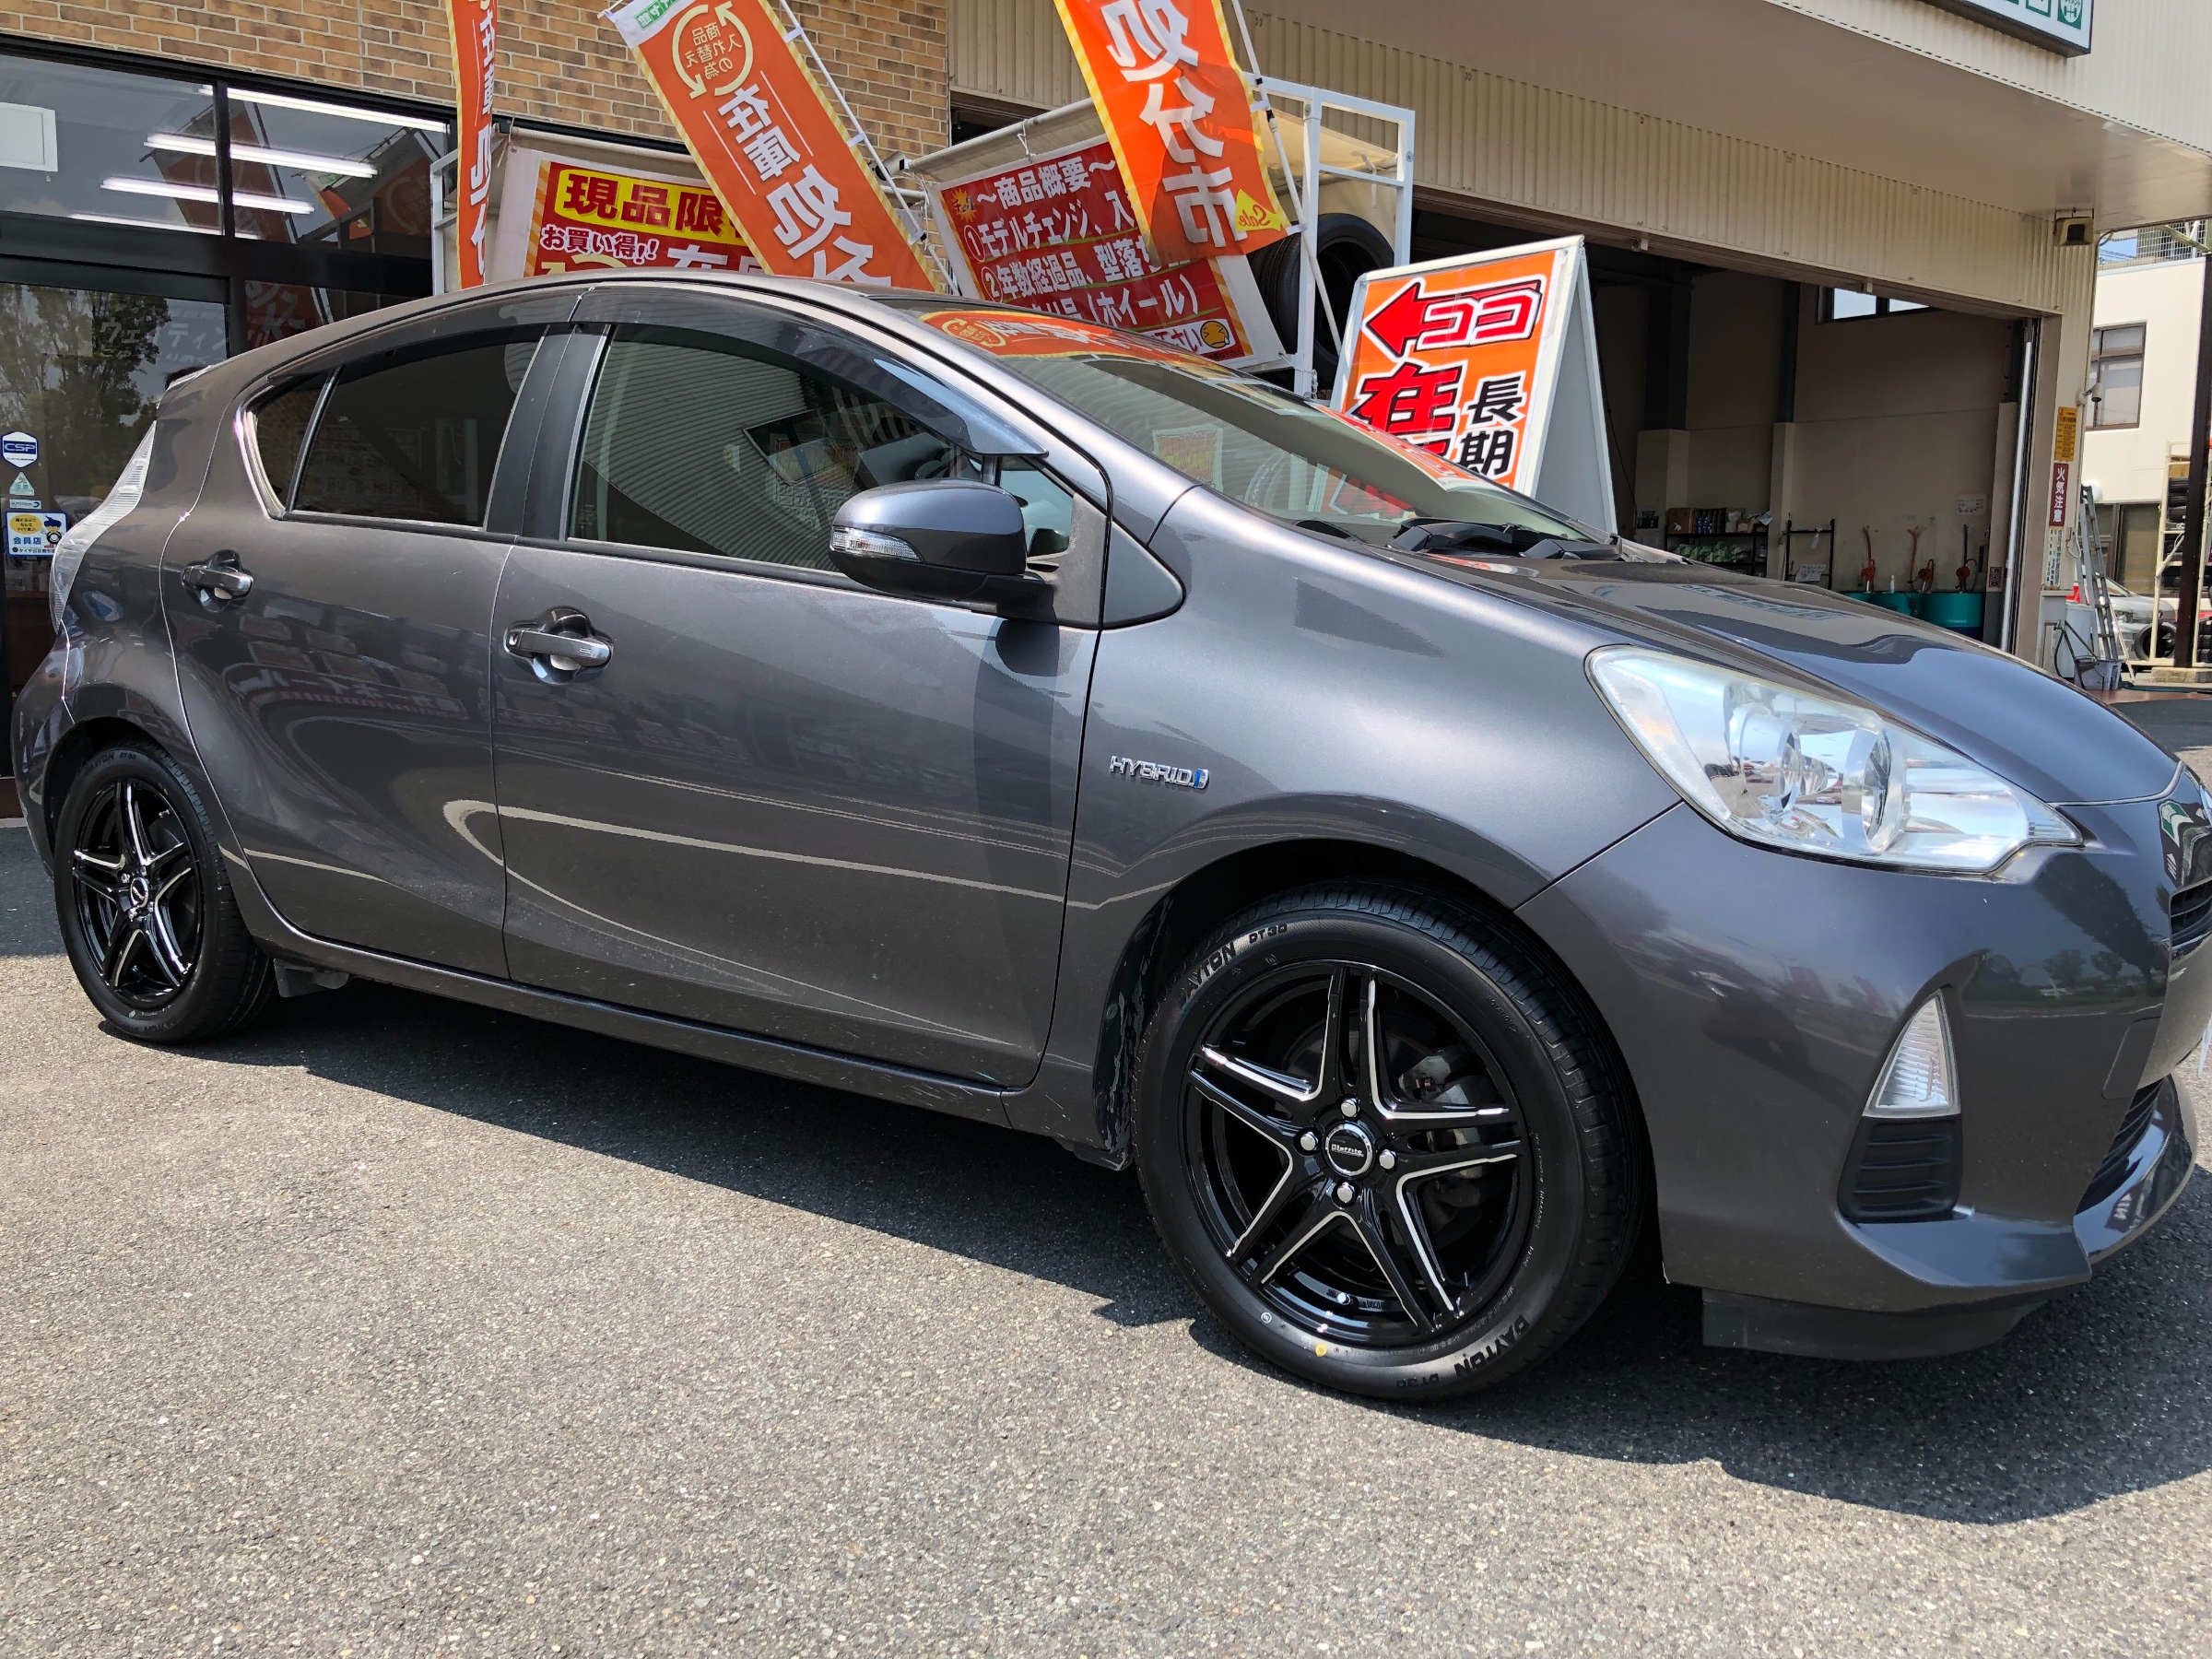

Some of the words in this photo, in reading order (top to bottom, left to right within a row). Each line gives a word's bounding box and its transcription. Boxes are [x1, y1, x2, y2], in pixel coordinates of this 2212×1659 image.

[563, 173, 743, 238] 現品限
[1416, 281, 1543, 348] ココ
[1351, 364, 1464, 453] 在
[1458, 374, 1524, 477] 長期
[4, 442, 36, 453] CSP
[2053, 466, 2066, 523] 火気注意
[13, 536, 41, 545] 会員店
[1109, 756, 1193, 786] HYBRID
[1453, 1313, 1532, 1379] DAYTON
